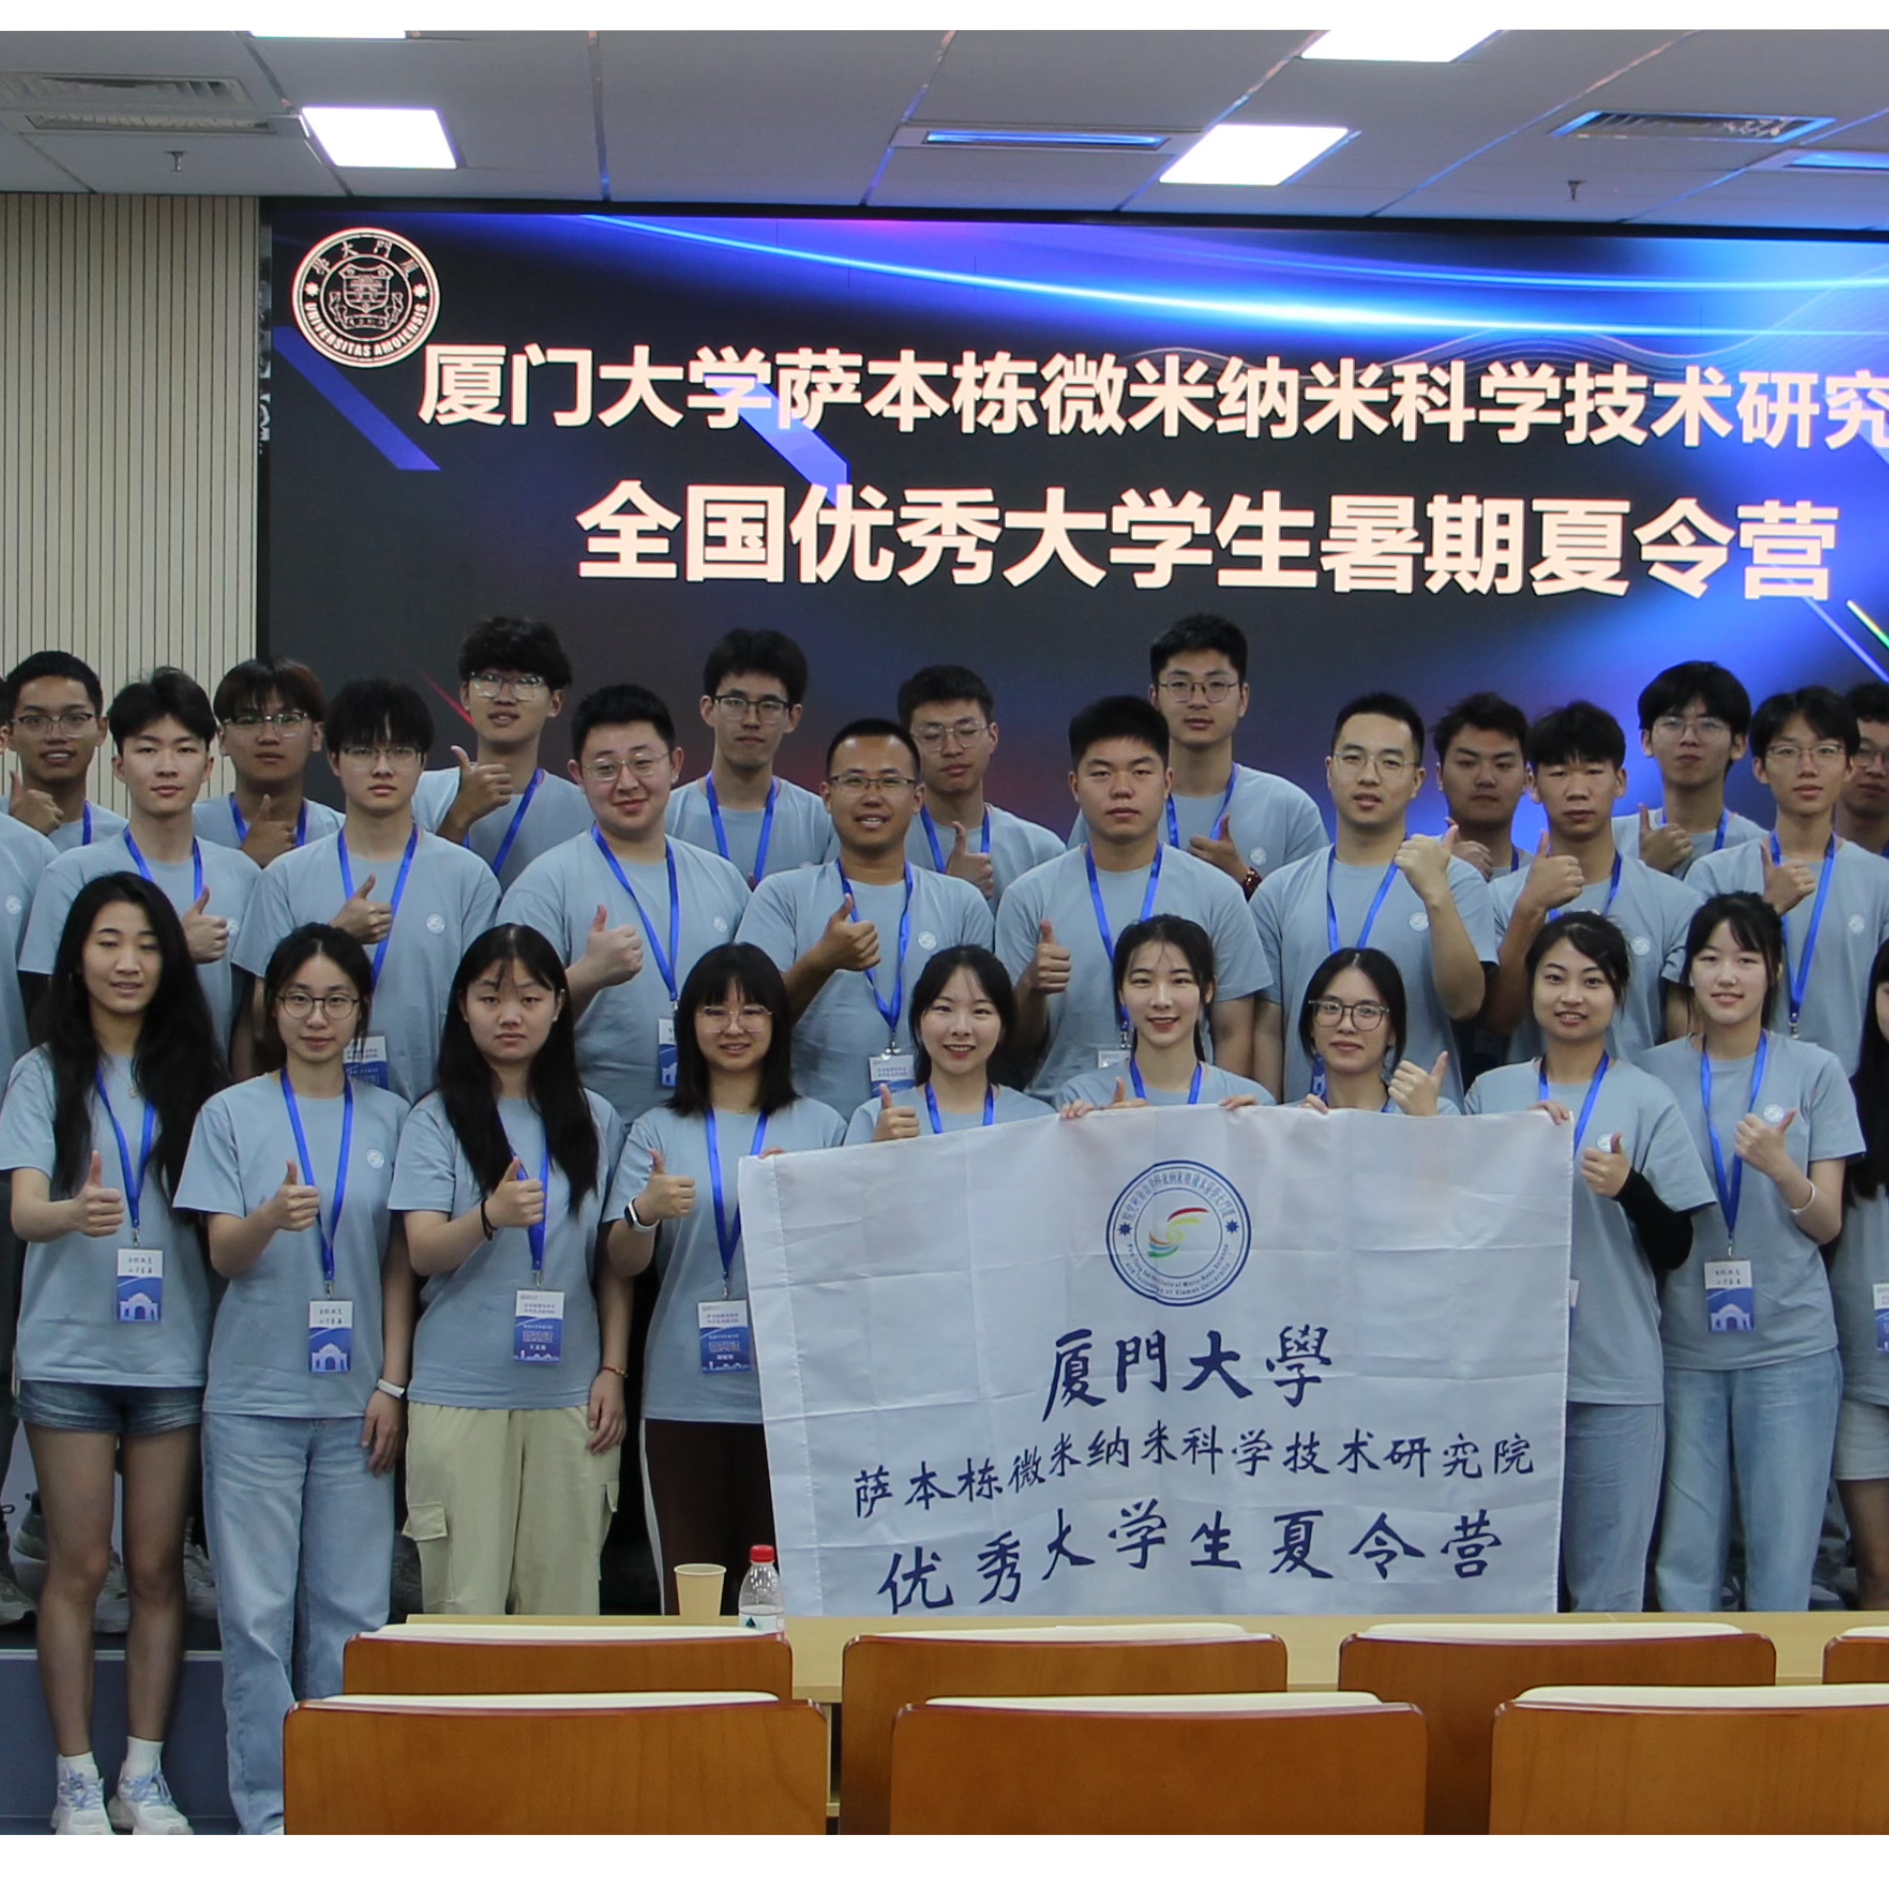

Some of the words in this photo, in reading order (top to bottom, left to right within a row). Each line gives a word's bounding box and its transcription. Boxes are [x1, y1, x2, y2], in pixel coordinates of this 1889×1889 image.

[304, 302, 372, 357] UNIVERSITAS
[373, 302, 428, 356] AMOIENSIS
[576, 480, 1839, 600] 全国优秀大学生暑期夏令营
[1042, 1324, 1333, 1422] 厦門大學
[853, 1420, 1535, 1520] 萨本栋微米纳米科学技术研究院
[875, 1497, 1503, 1615] 优秀大学生夏令营
